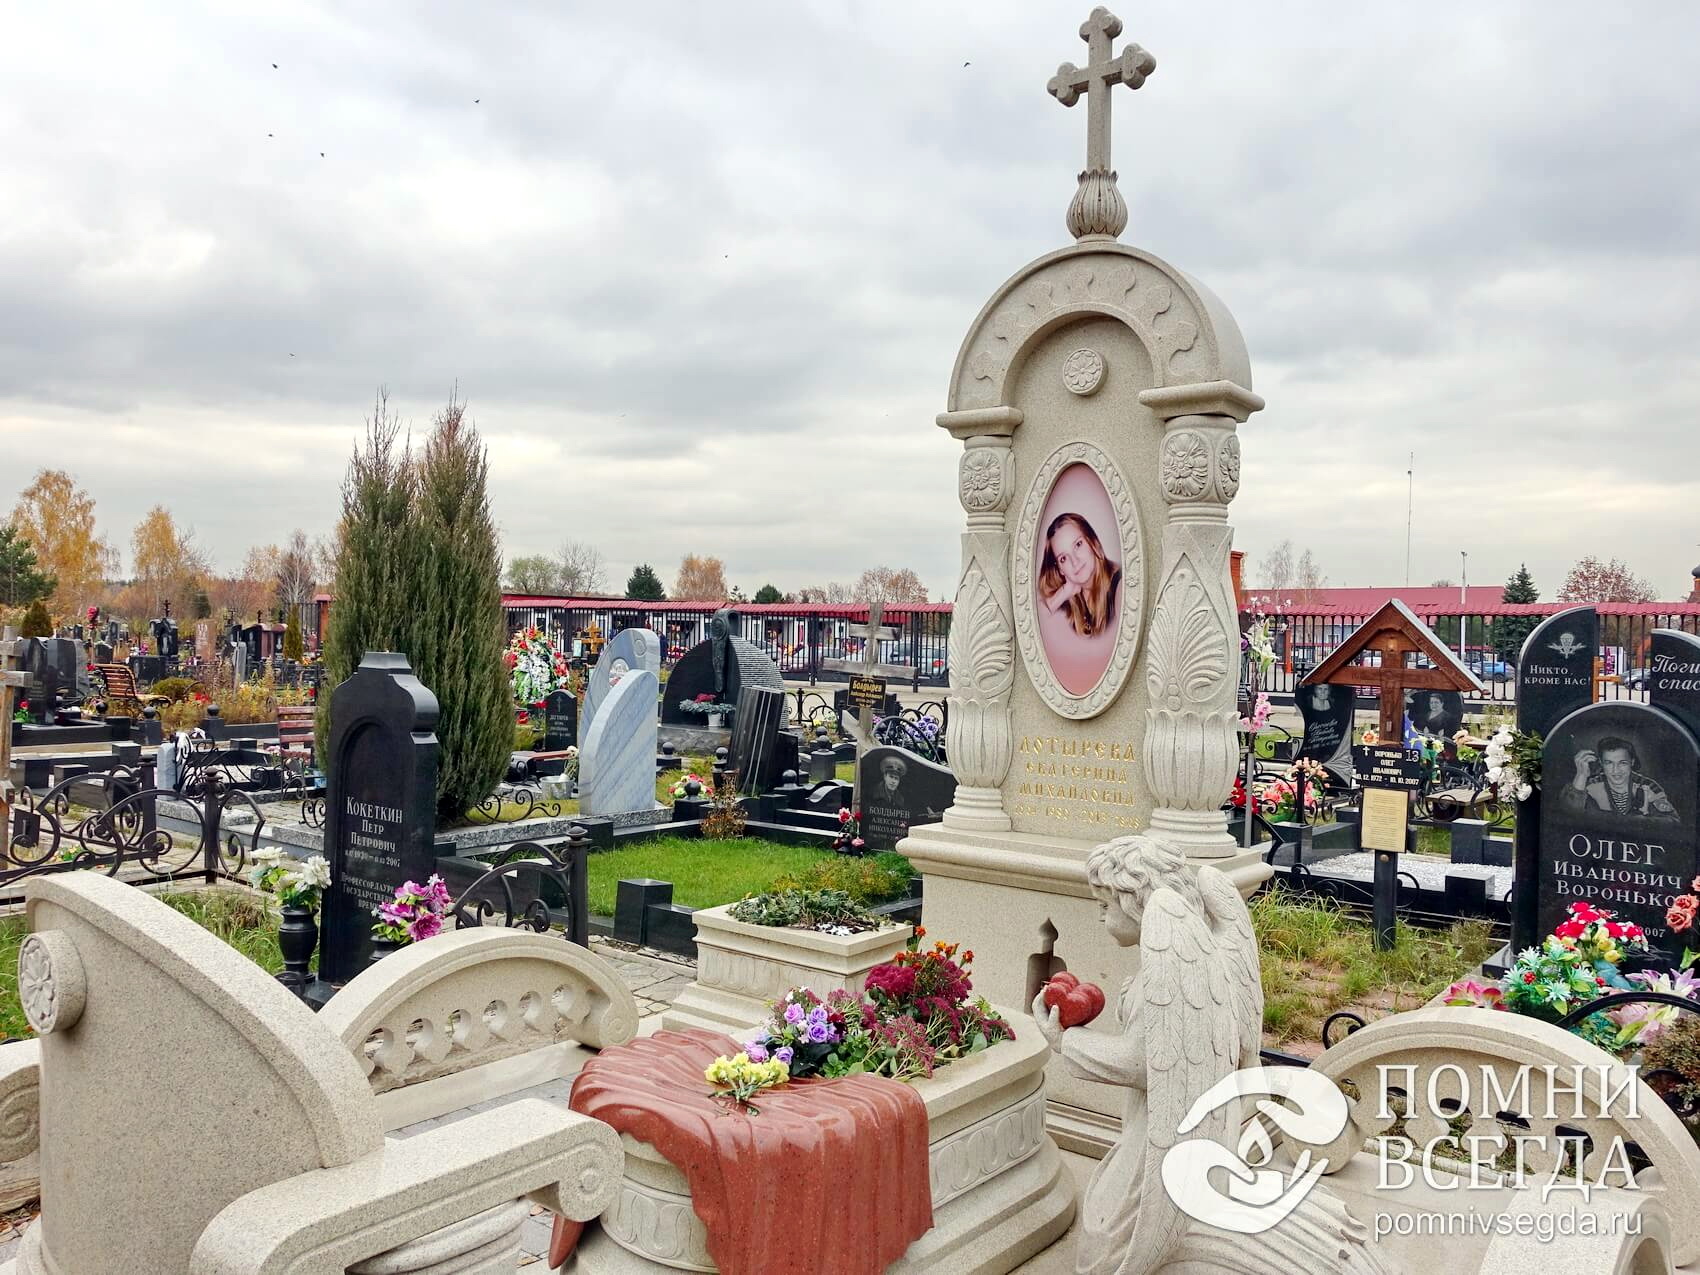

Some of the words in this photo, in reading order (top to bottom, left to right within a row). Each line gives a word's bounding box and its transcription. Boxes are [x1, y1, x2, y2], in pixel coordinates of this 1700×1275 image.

[1524, 676, 1561, 686] КРОМЕ
[1406, 749, 1419, 762] 13
[346, 797, 402, 823] КОКЕТКИН
[869, 806, 911, 819] БОЛДЫРЕВ
[361, 819, 385, 835] ПЕТР
[350, 832, 396, 853] ПЕТРОВИЧ
[1569, 834, 1665, 866] ОЛЕГ
[1553, 860, 1682, 890] ИВАНОВИЧ
[1556, 880, 1677, 909] ВОРОНЬКО
